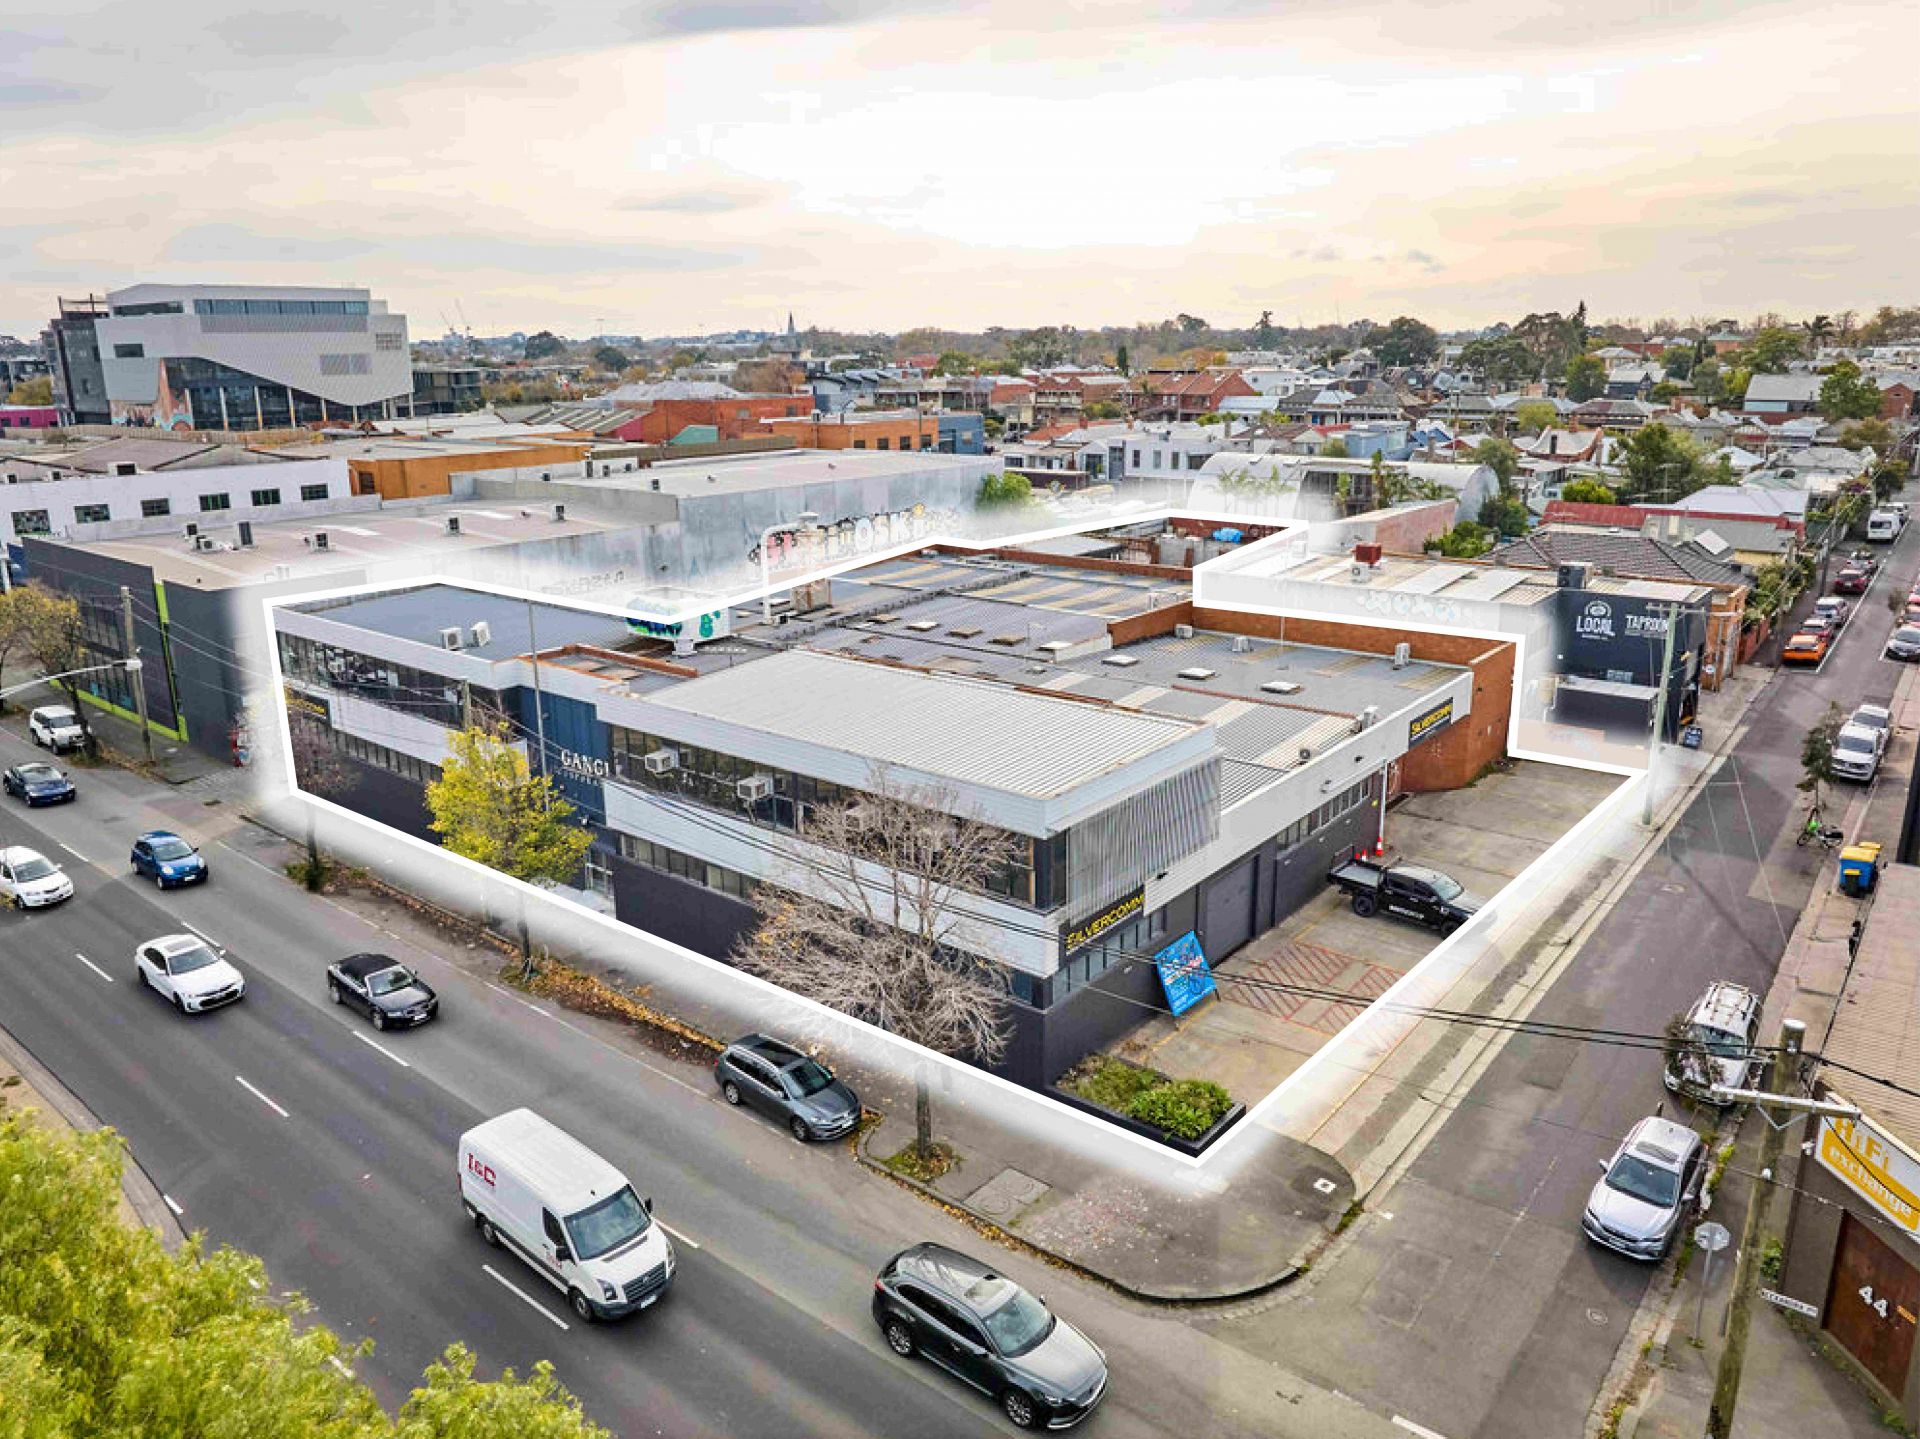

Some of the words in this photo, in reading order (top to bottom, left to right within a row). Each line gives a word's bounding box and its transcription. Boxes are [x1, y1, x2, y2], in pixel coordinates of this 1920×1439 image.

[1576, 615, 1615, 637] LOCAL
[561, 749, 609, 778] GANGI
[1829, 1145, 1912, 1218] exchange
[1858, 1285, 1889, 1318] 44
